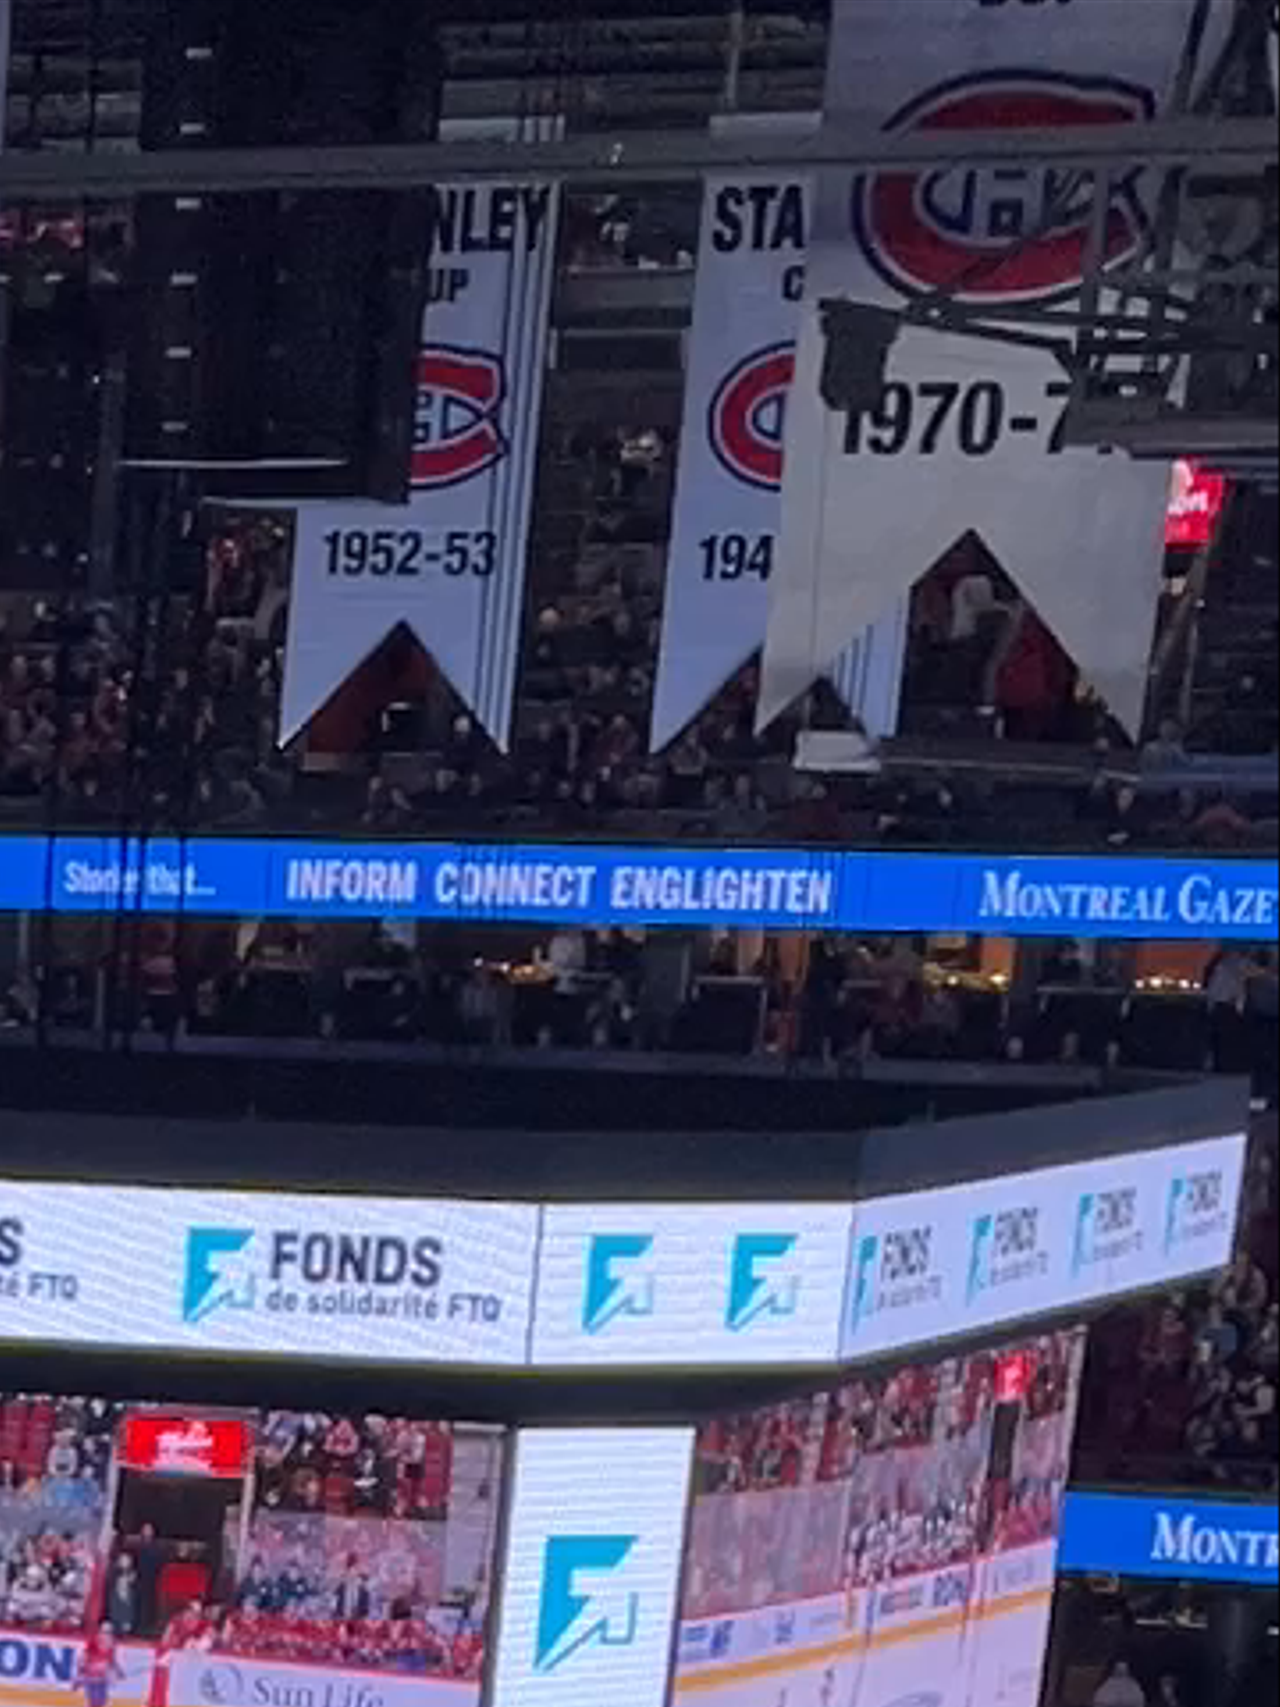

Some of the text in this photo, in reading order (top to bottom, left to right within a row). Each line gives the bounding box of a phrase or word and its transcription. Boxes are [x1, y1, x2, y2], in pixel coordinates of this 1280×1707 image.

[322, 531, 496, 578] 1952-53
[287, 858, 832, 913] INFORM CONNECT ENGLIGHTEN
[980, 870, 1170, 920] MONTREAL
[269, 1232, 442, 1288] FONDS
[28, 1274, 79, 1301] FTQ
[265, 1287, 503, 1323] de solidarité FTQ
